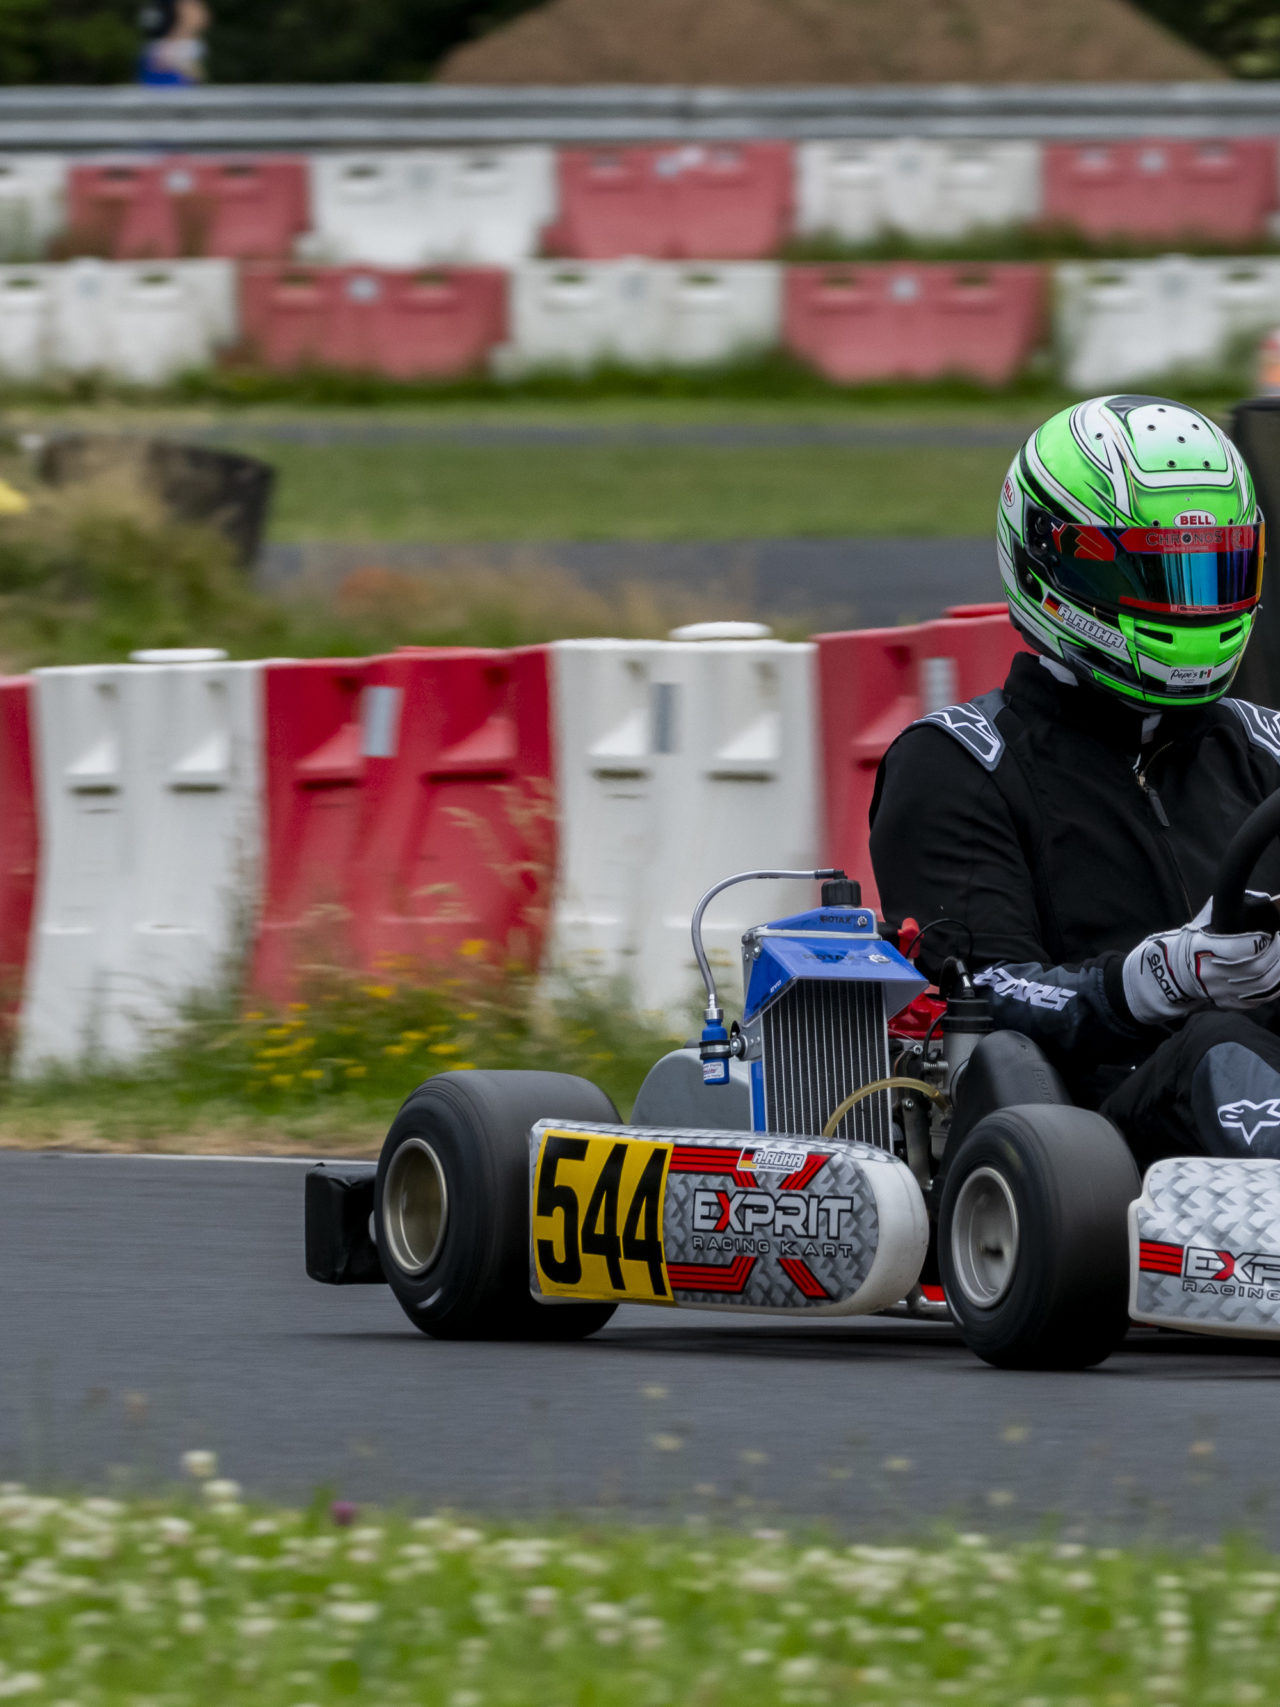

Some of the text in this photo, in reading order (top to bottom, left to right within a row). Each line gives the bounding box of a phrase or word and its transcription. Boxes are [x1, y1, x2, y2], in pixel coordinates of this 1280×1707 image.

[1180, 515, 1212, 525] BELL
[1147, 953, 1181, 1004] spar
[537, 1136, 668, 1296] 544
[692, 1189, 854, 1240] EXPRIT
[692, 1235, 854, 1259] RACING KART
